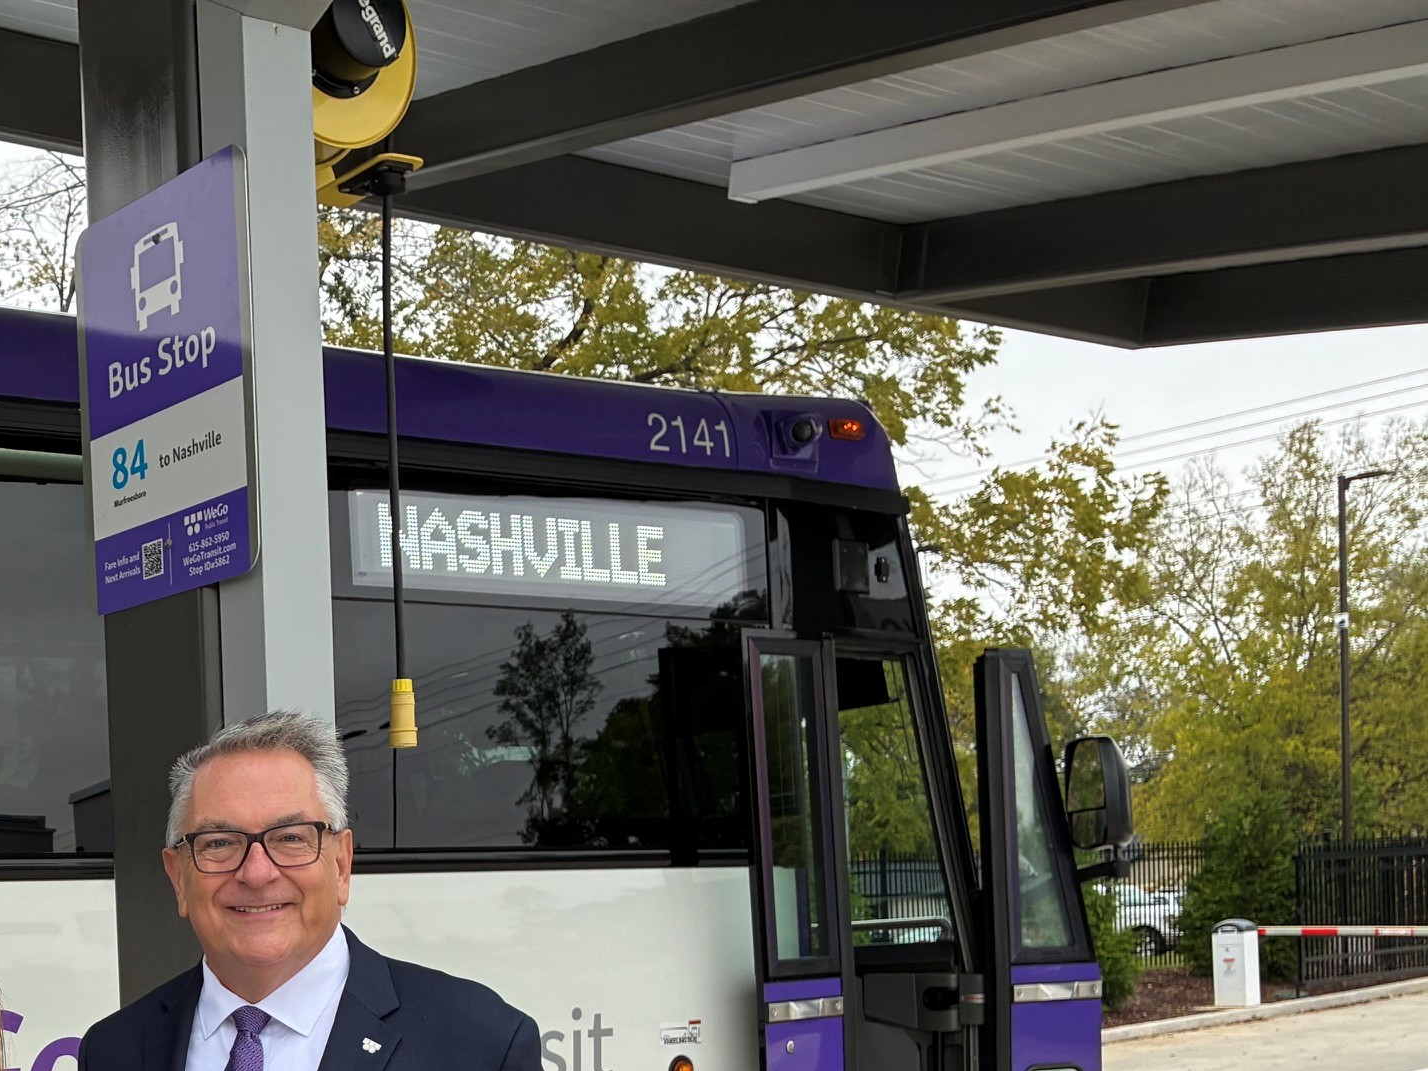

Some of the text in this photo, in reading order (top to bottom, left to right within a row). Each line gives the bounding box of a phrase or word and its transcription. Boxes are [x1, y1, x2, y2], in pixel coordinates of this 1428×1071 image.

[108, 326, 216, 399] Bus Stop
[647, 412, 731, 458] 2141
[159, 430, 222, 469] to Nashville
[112, 438, 148, 490] 84
[113, 490, 147, 508] Murfreesboro
[203, 503, 229, 522] WeGo
[204, 517, 229, 530] Public Transit
[188, 530, 230, 553] 615-862-5950
[377, 502, 667, 586] NASHVILLE
[104, 551, 140, 571] Fare Info and
[183, 542, 237, 567] WeGoTransit.com
[104, 565, 141, 584] Next Arrivals
[189, 565, 203, 576] Stop
